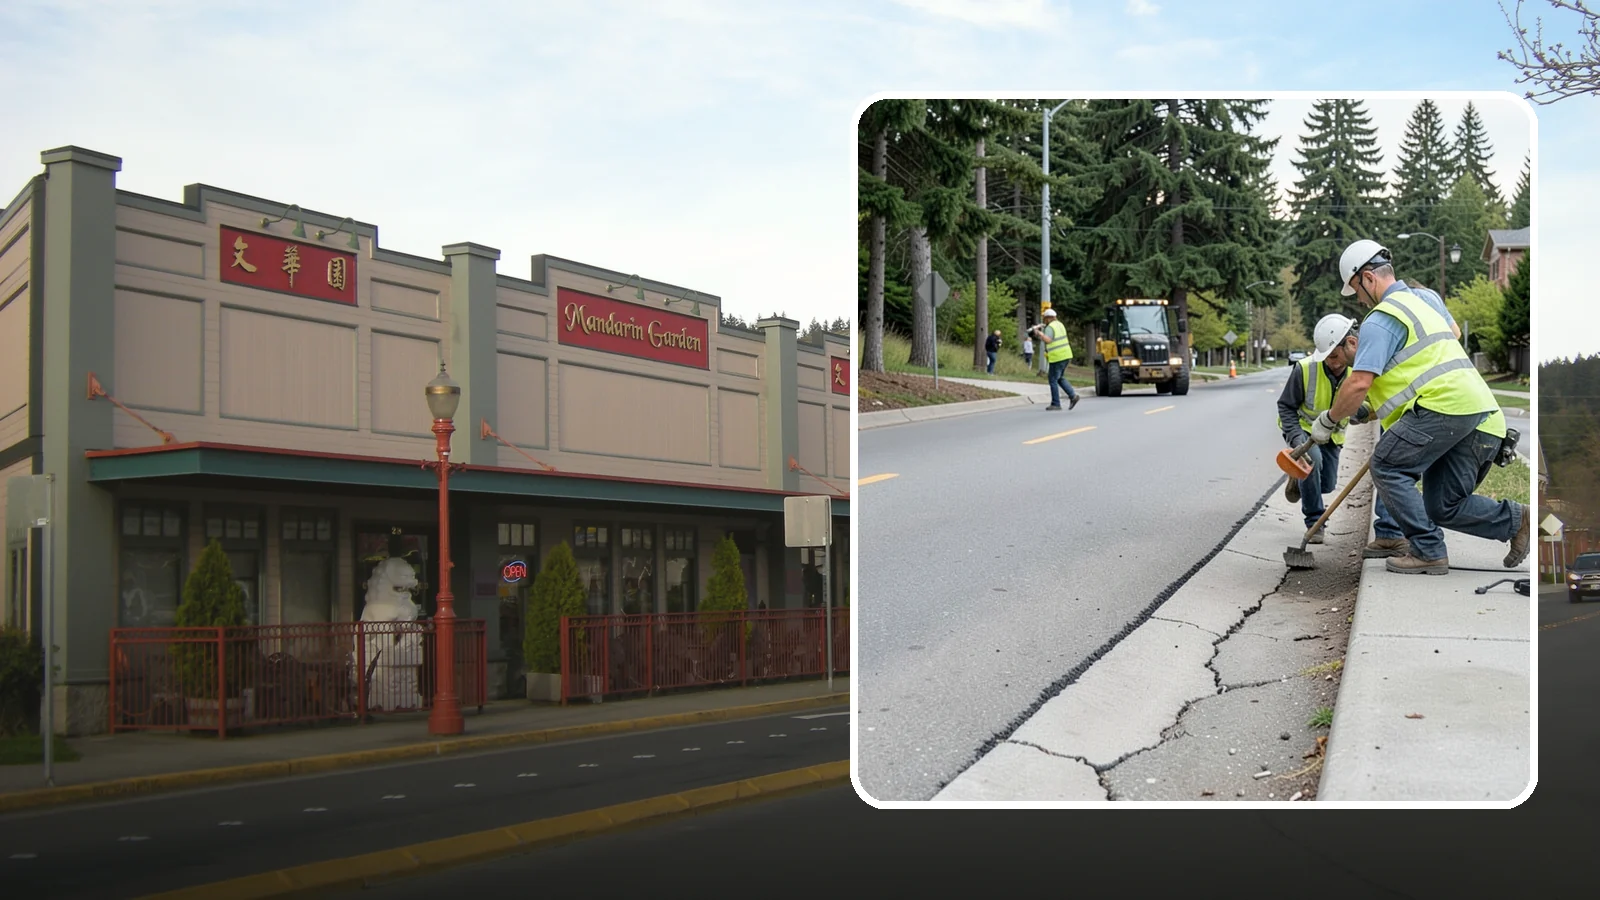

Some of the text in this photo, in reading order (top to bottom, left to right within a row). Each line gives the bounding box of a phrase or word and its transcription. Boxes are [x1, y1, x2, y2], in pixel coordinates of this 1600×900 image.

[231, 236, 346, 290] 文華園
[564, 302, 702, 352] Mandarin Garden
[503, 565, 527, 578] OPEN
